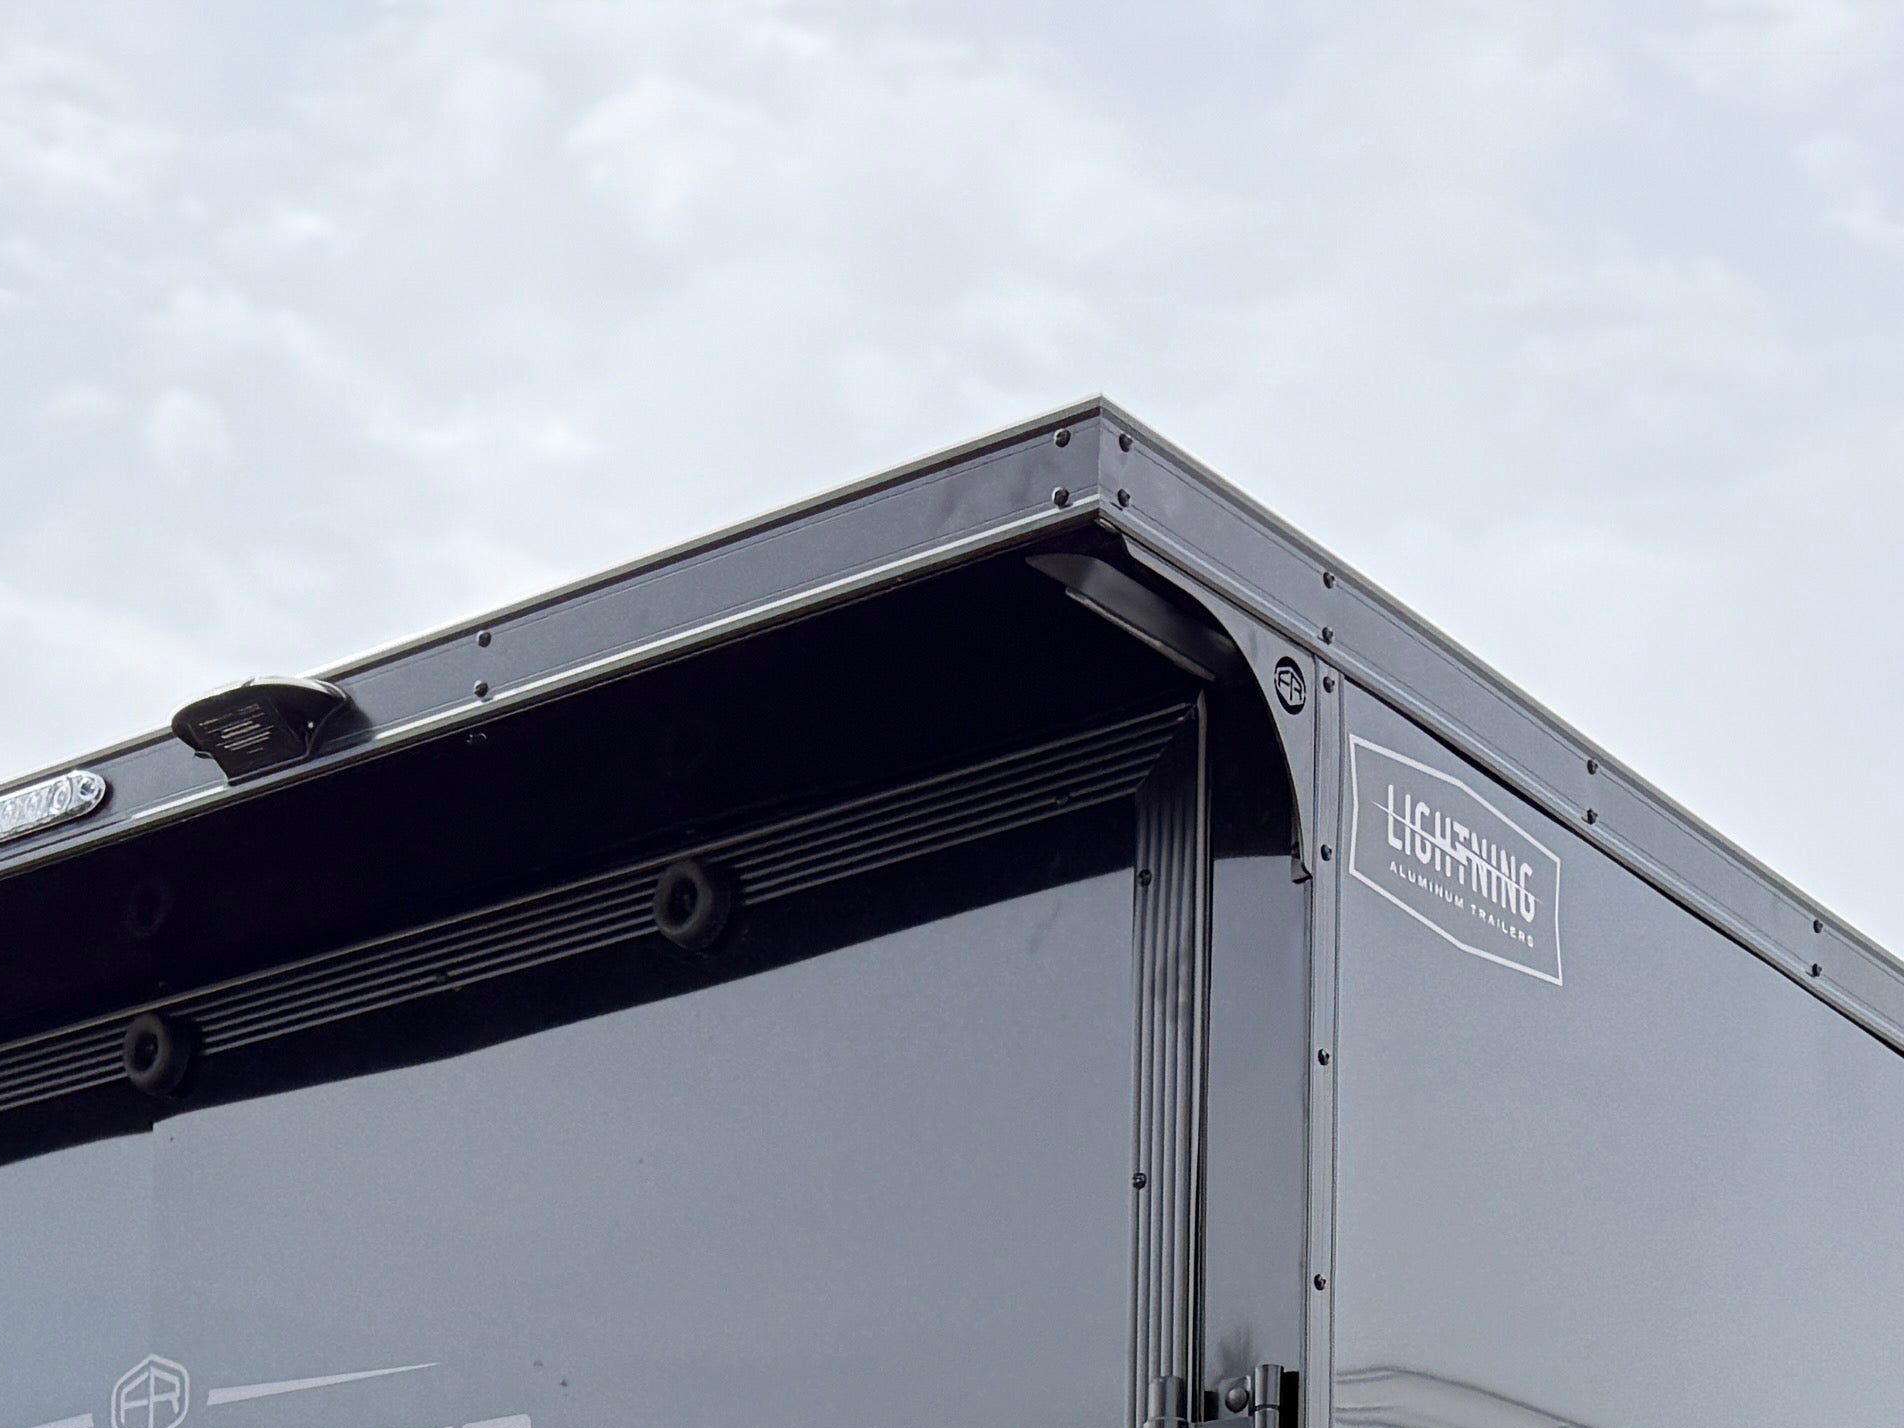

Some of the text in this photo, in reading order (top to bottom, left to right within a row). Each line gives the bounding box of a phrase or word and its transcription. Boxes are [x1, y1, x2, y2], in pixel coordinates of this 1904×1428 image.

[1387, 784, 1536, 923] LIGHTNING
[1389, 861, 1535, 948] ALUMINUM TRAILERS
